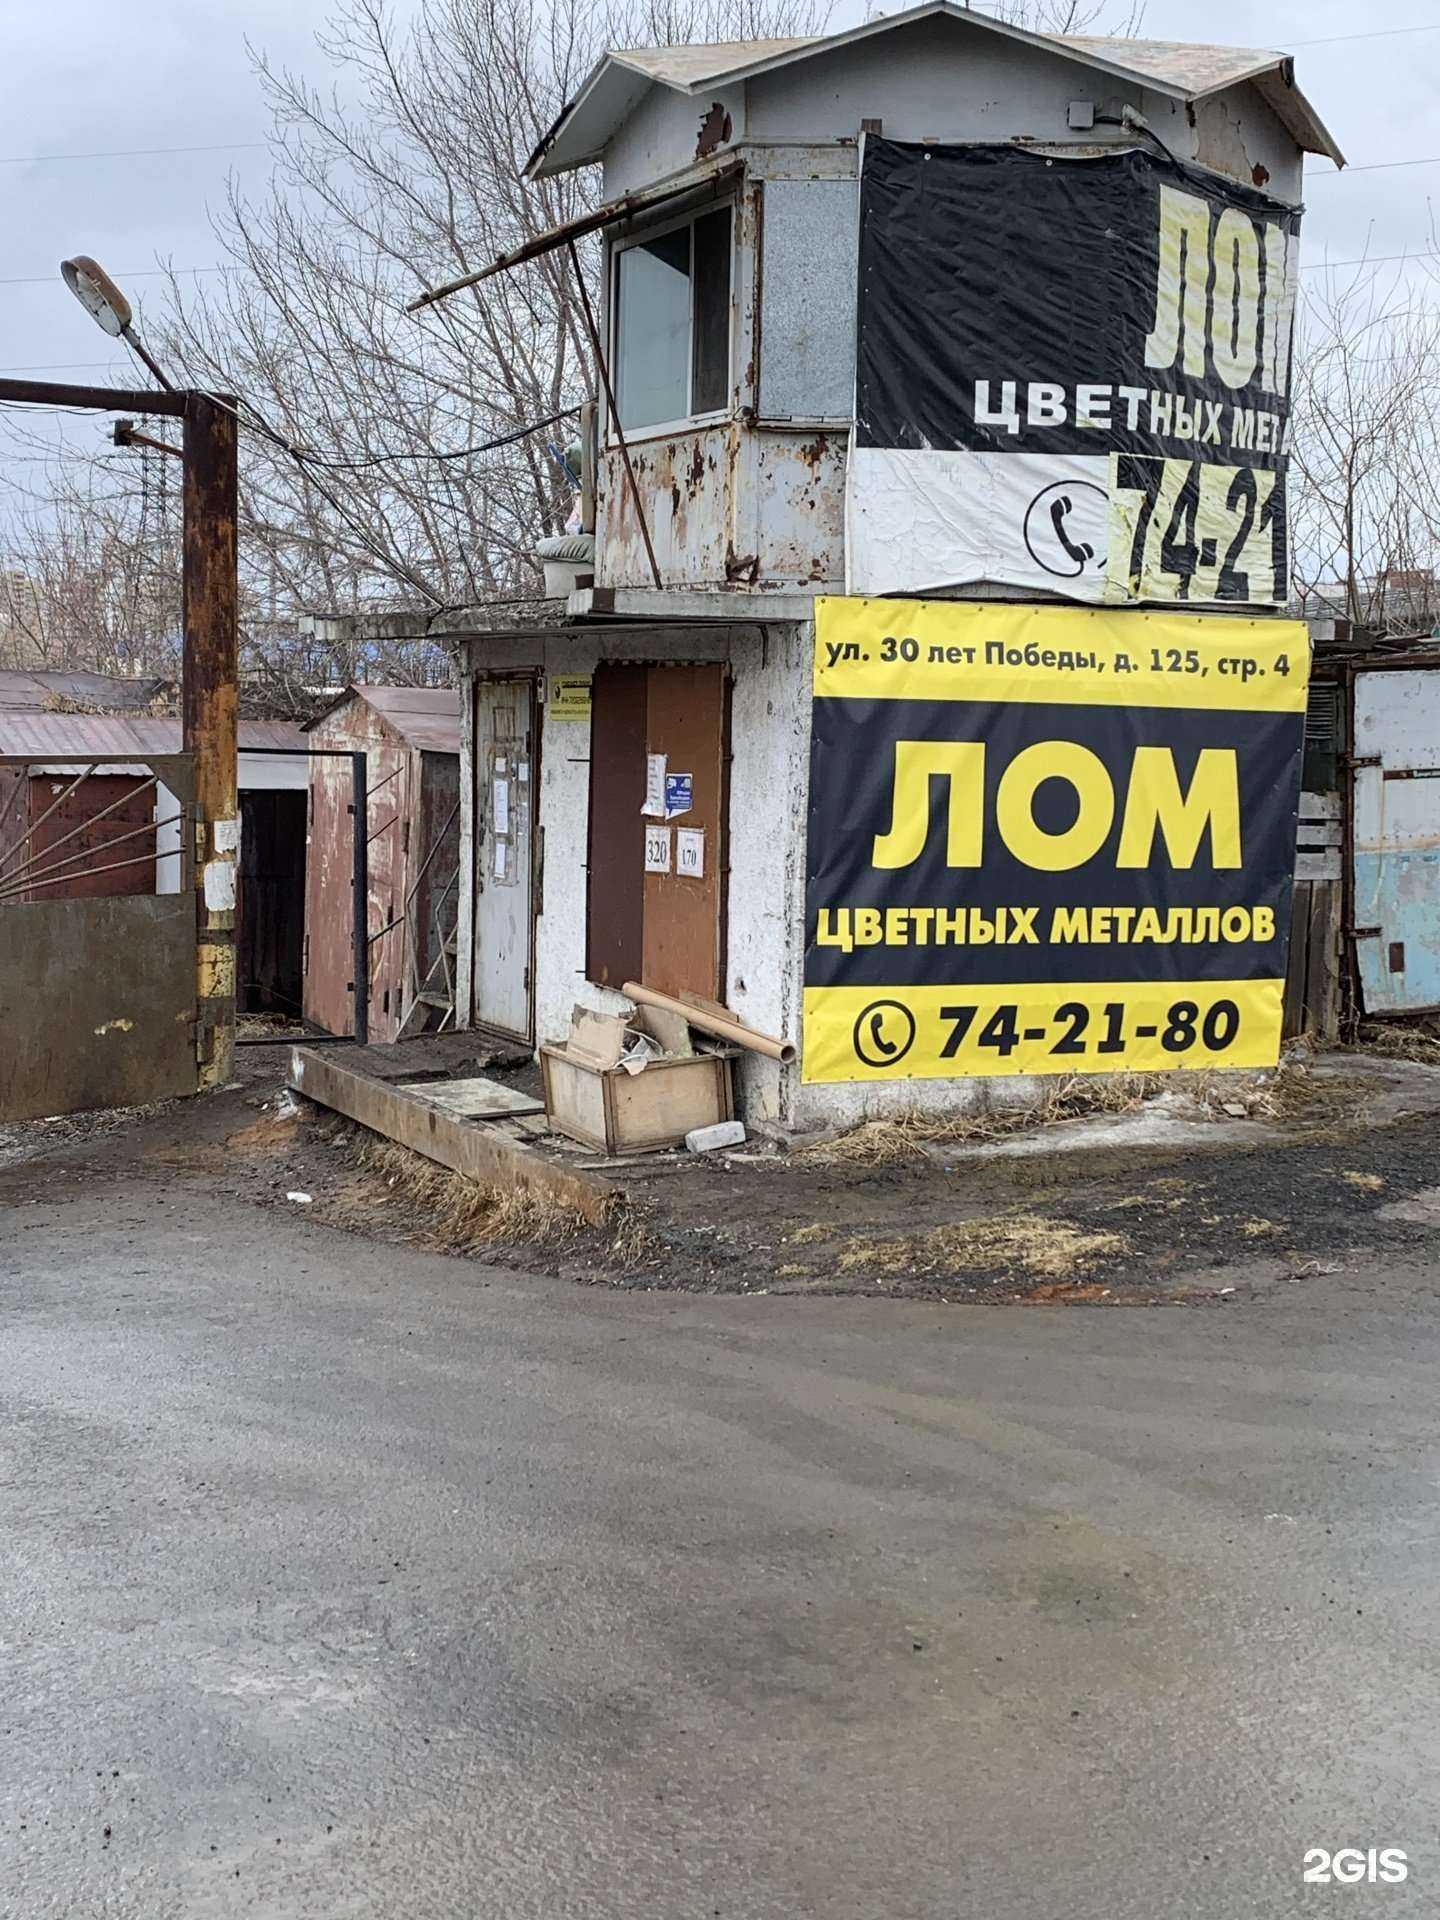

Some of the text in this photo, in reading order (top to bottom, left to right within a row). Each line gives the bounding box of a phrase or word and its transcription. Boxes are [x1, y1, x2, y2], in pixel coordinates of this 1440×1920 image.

[974, 380, 1223, 445] ЦВЕТНЫХ
[825, 638, 1290, 681] ул. 30 лет Победы, д. 125, стр. 4
[871, 740, 1242, 871] ЛОМ
[647, 840, 667, 864] 320
[682, 848, 697, 866] 170
[816, 906, 1275, 953] ЦВЕТНЫХ МЕТАЛЛОВ
[938, 999, 1240, 1058] 74-21-80
